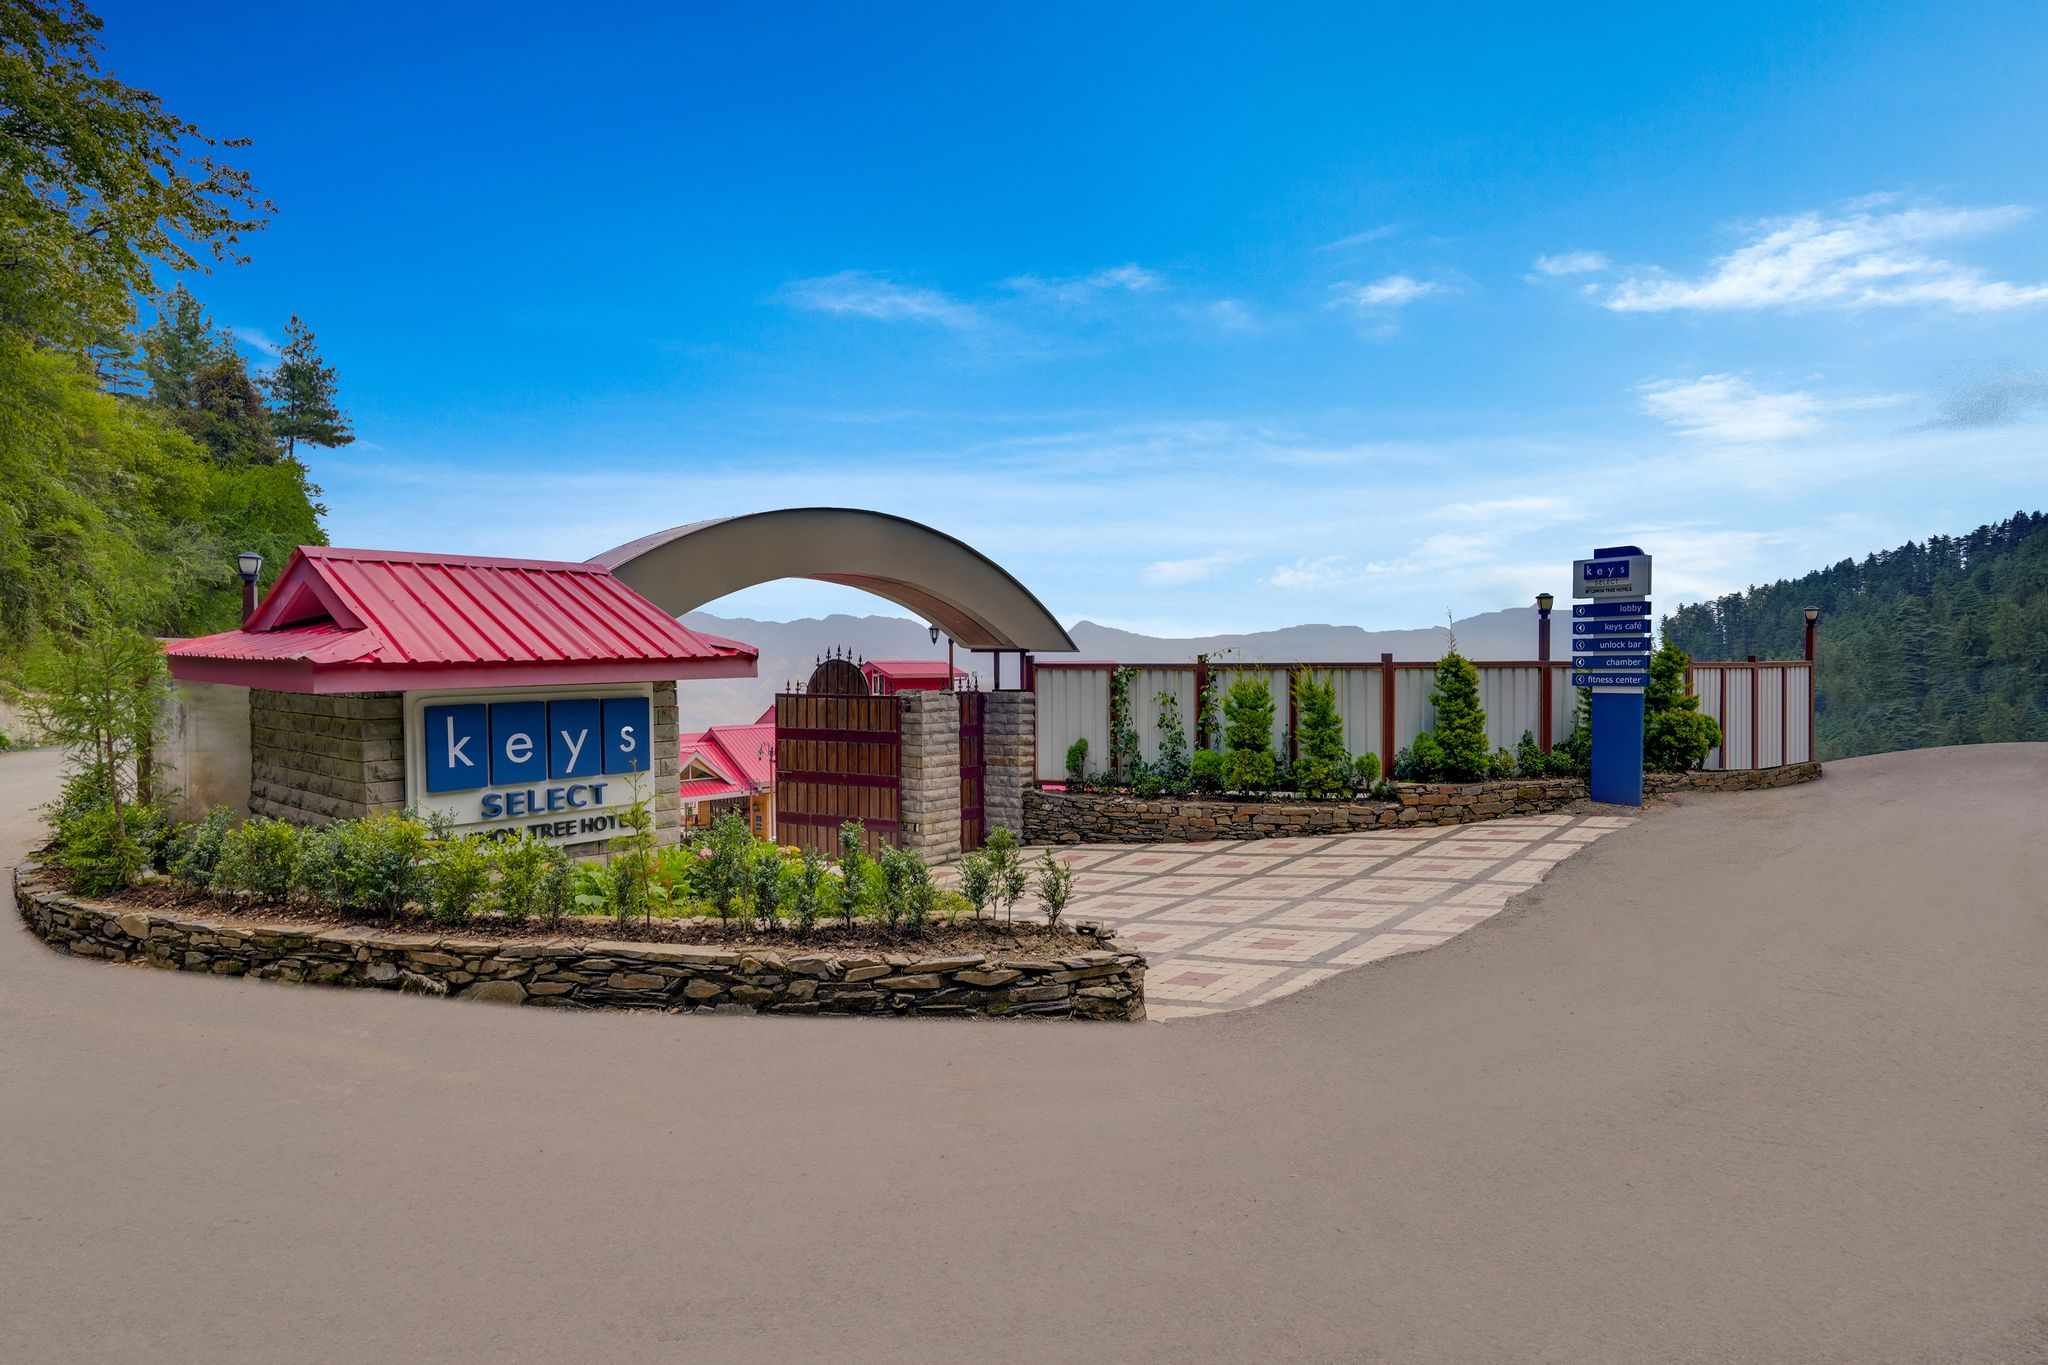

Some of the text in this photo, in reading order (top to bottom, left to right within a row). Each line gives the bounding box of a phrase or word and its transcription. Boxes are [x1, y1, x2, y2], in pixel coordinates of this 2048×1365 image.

[1586, 565, 1625, 577] keys
[1620, 604, 1642, 613] lobby
[1604, 622, 1642, 632] keys café
[1599, 640, 1642, 649] unlock bar
[1606, 658, 1642, 666] chamber
[1588, 676, 1642, 684] fitness center
[446, 716, 636, 773] keys
[482, 783, 608, 817] SELECT
[528, 819, 577, 840] TREE
